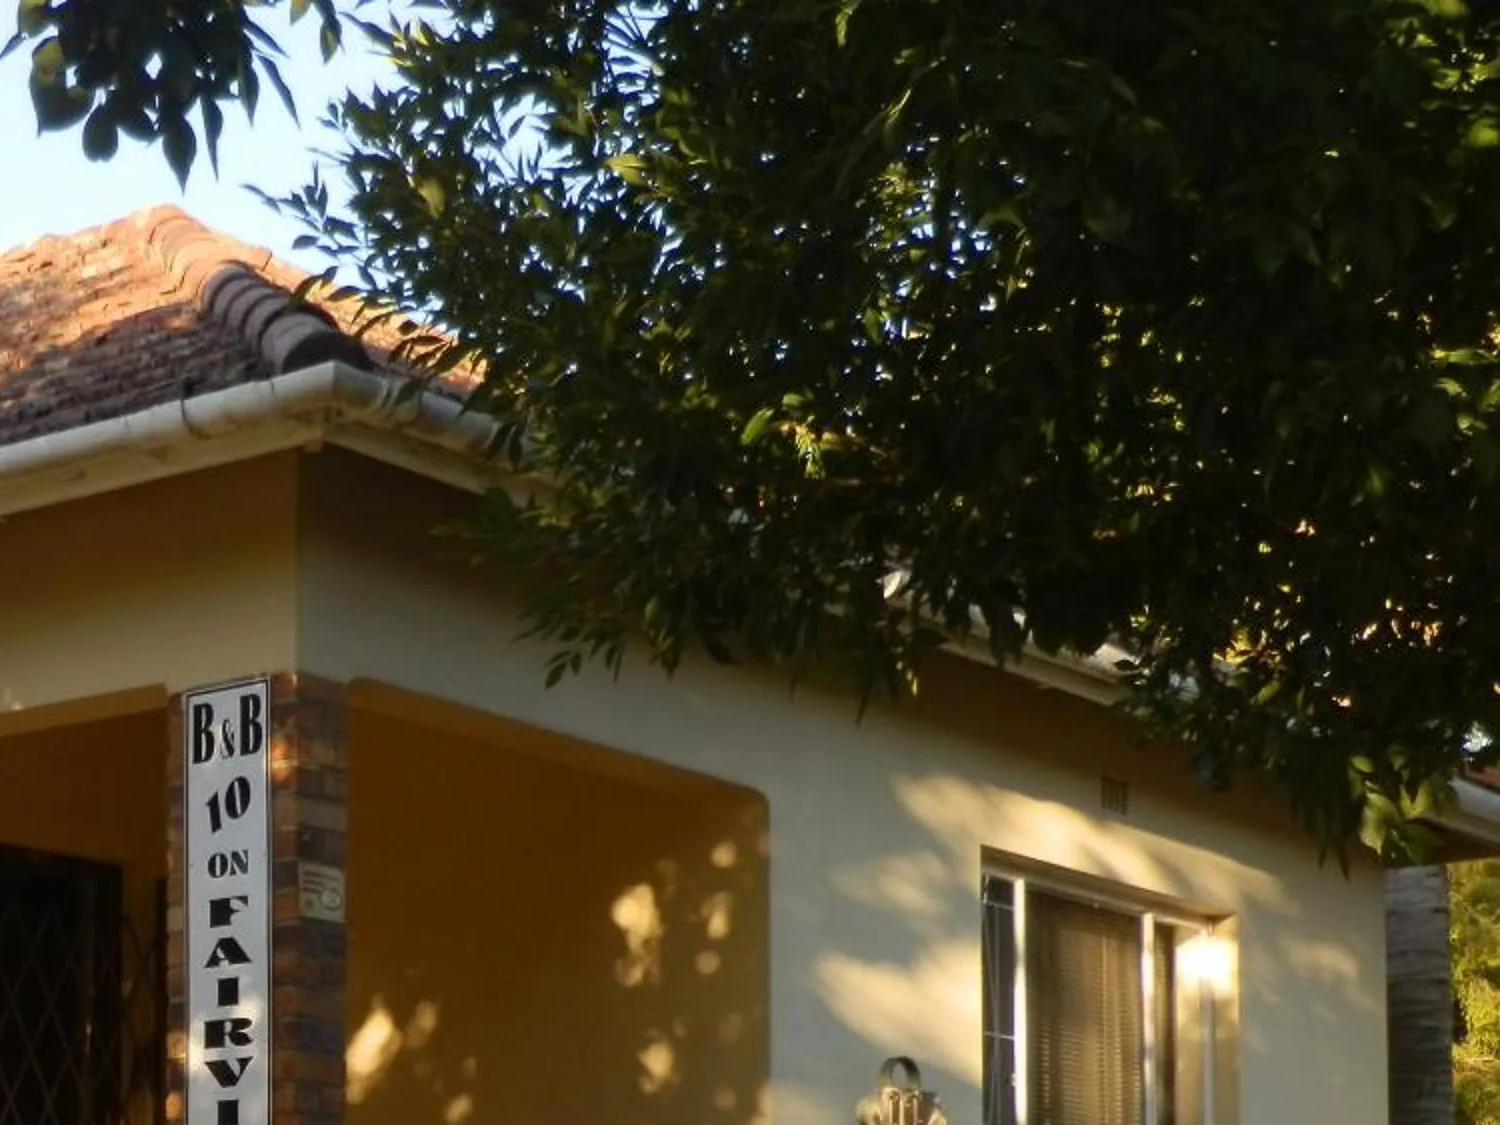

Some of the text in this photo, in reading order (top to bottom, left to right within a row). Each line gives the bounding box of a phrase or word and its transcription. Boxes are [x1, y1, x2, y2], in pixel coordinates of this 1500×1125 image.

[192, 693, 263, 764] B&B
[206, 775, 251, 834] 10
[207, 849, 249, 878] ON
